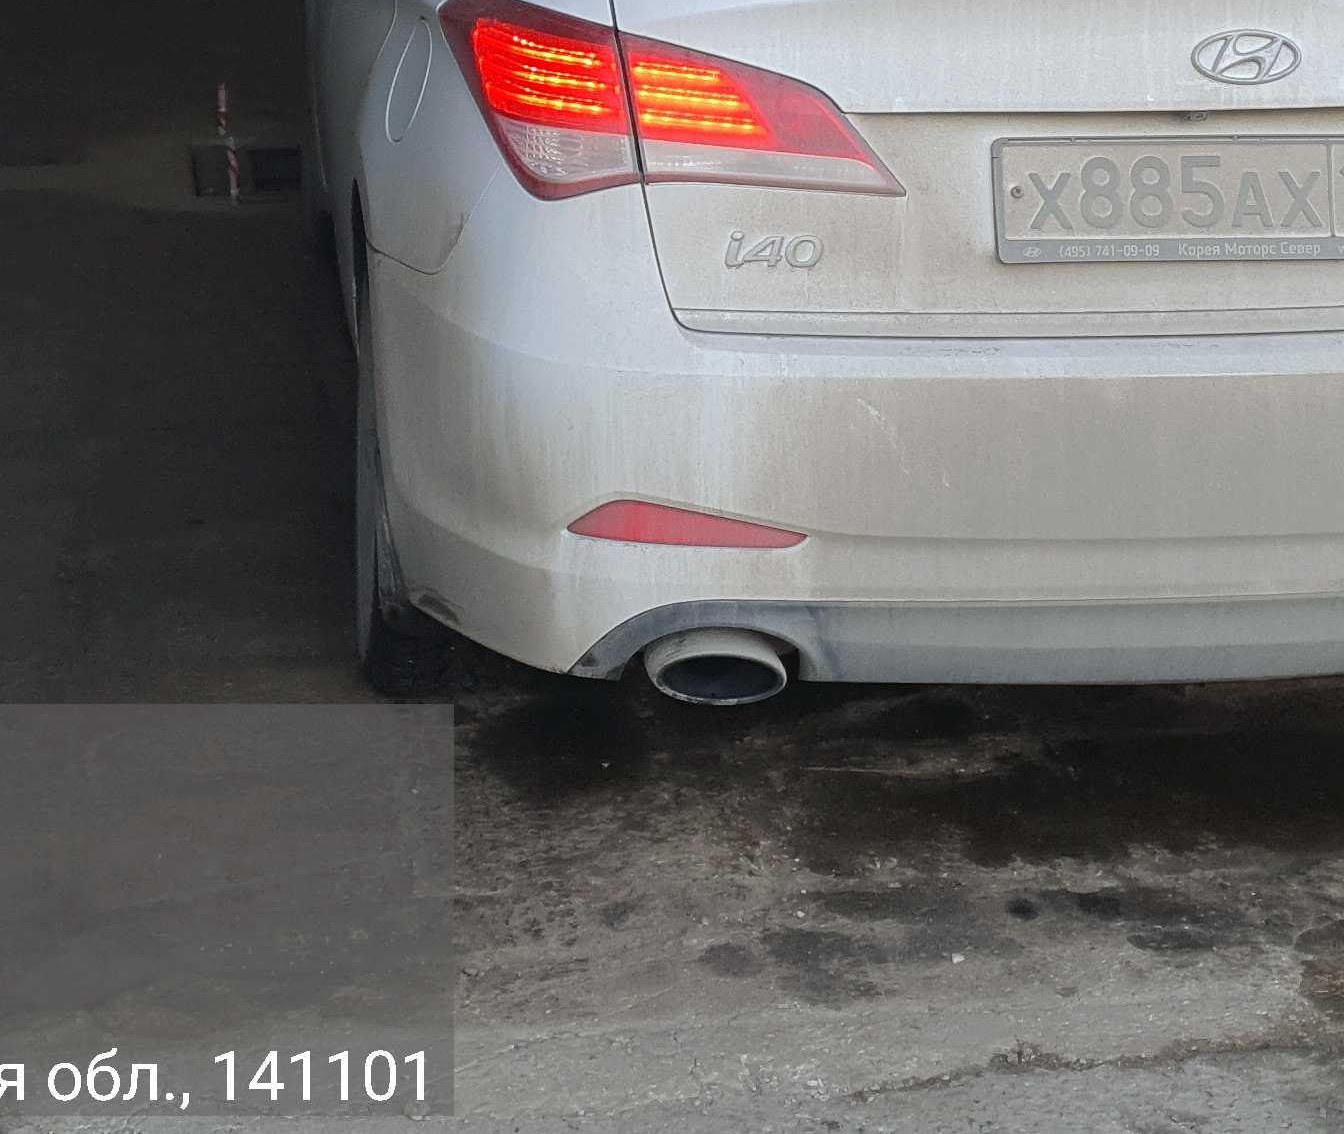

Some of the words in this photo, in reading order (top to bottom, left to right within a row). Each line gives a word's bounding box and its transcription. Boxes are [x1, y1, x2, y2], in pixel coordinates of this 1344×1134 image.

[724, 230, 824, 267] i40
[1177, 242, 1221, 258] Корея
[1224, 241, 1277, 257] Моторс
[1280, 241, 1321, 258] Север
